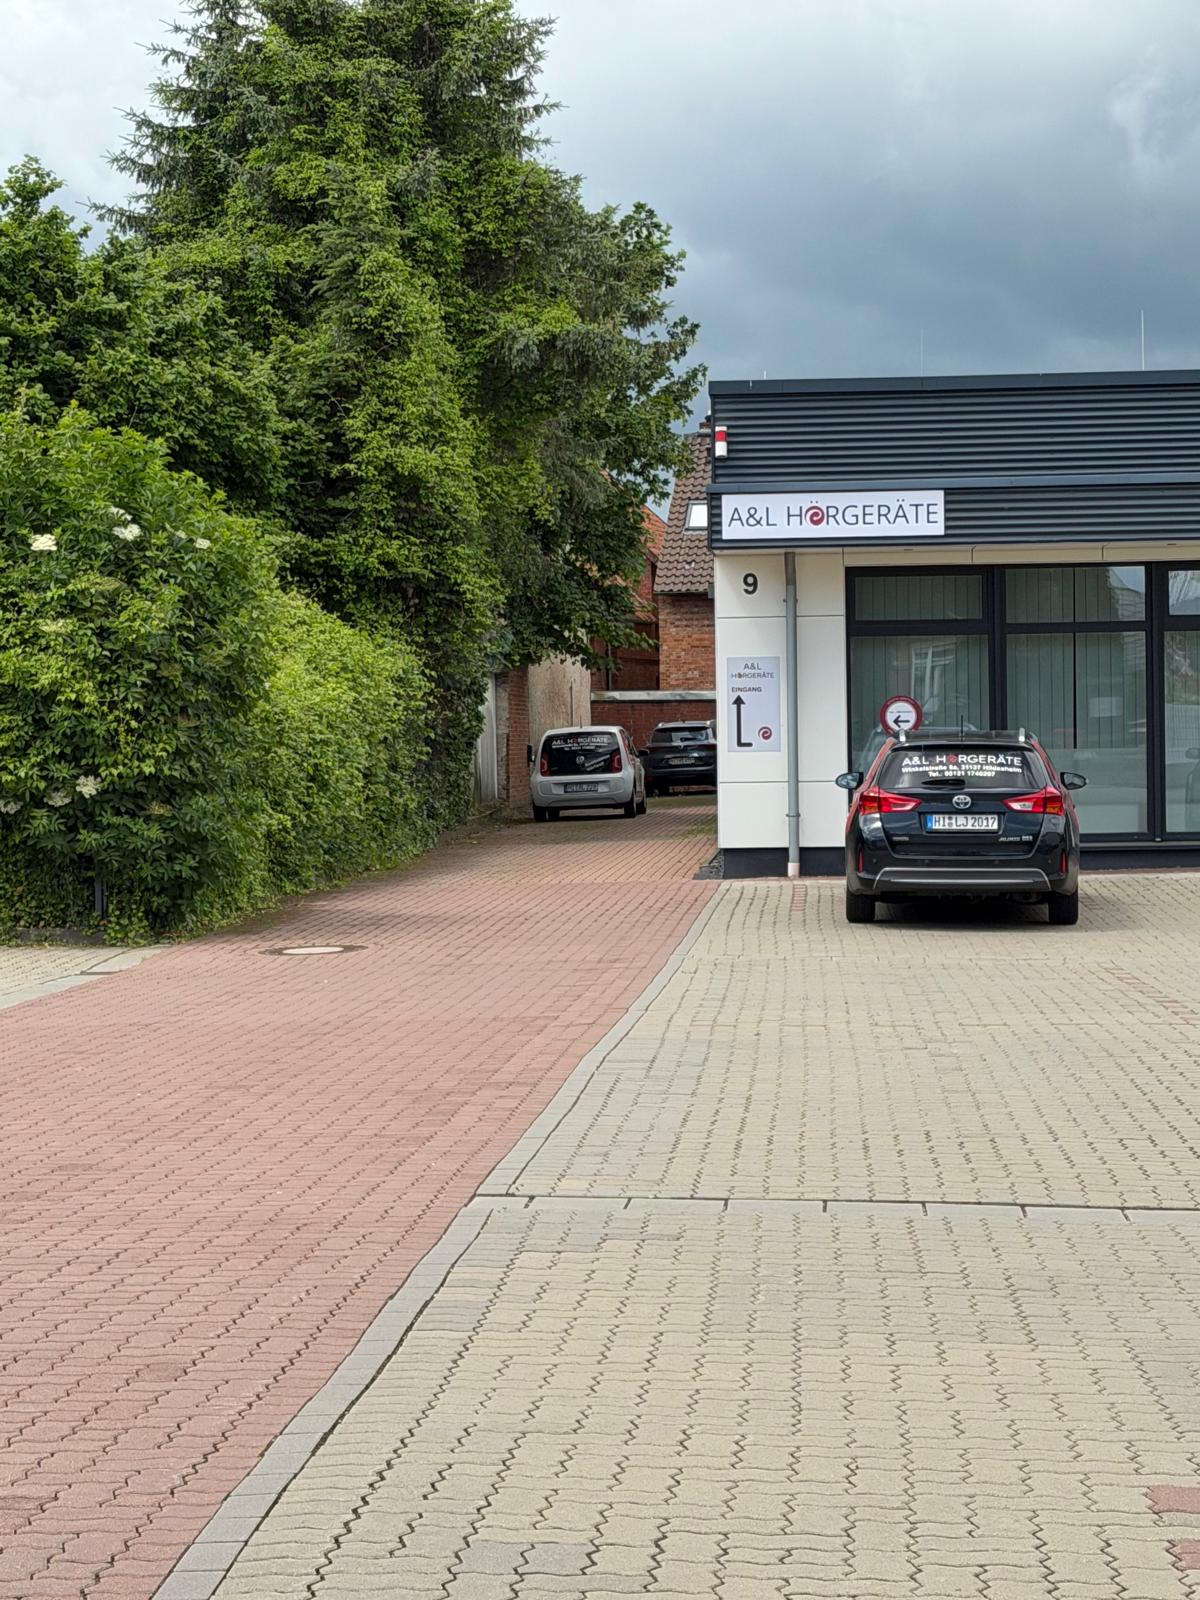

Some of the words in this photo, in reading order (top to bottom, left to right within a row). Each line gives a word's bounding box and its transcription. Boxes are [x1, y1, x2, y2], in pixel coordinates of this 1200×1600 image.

[728, 506, 777, 527] A&L
[786, 498, 938, 527] HÖRGERÄTE
[743, 573, 758, 595] 9
[743, 662, 762, 670] A&L
[902, 755, 930, 766] A&L
[934, 815, 946, 828] HI
[955, 815, 968, 828] LJ
[972, 815, 996, 828] 2017
